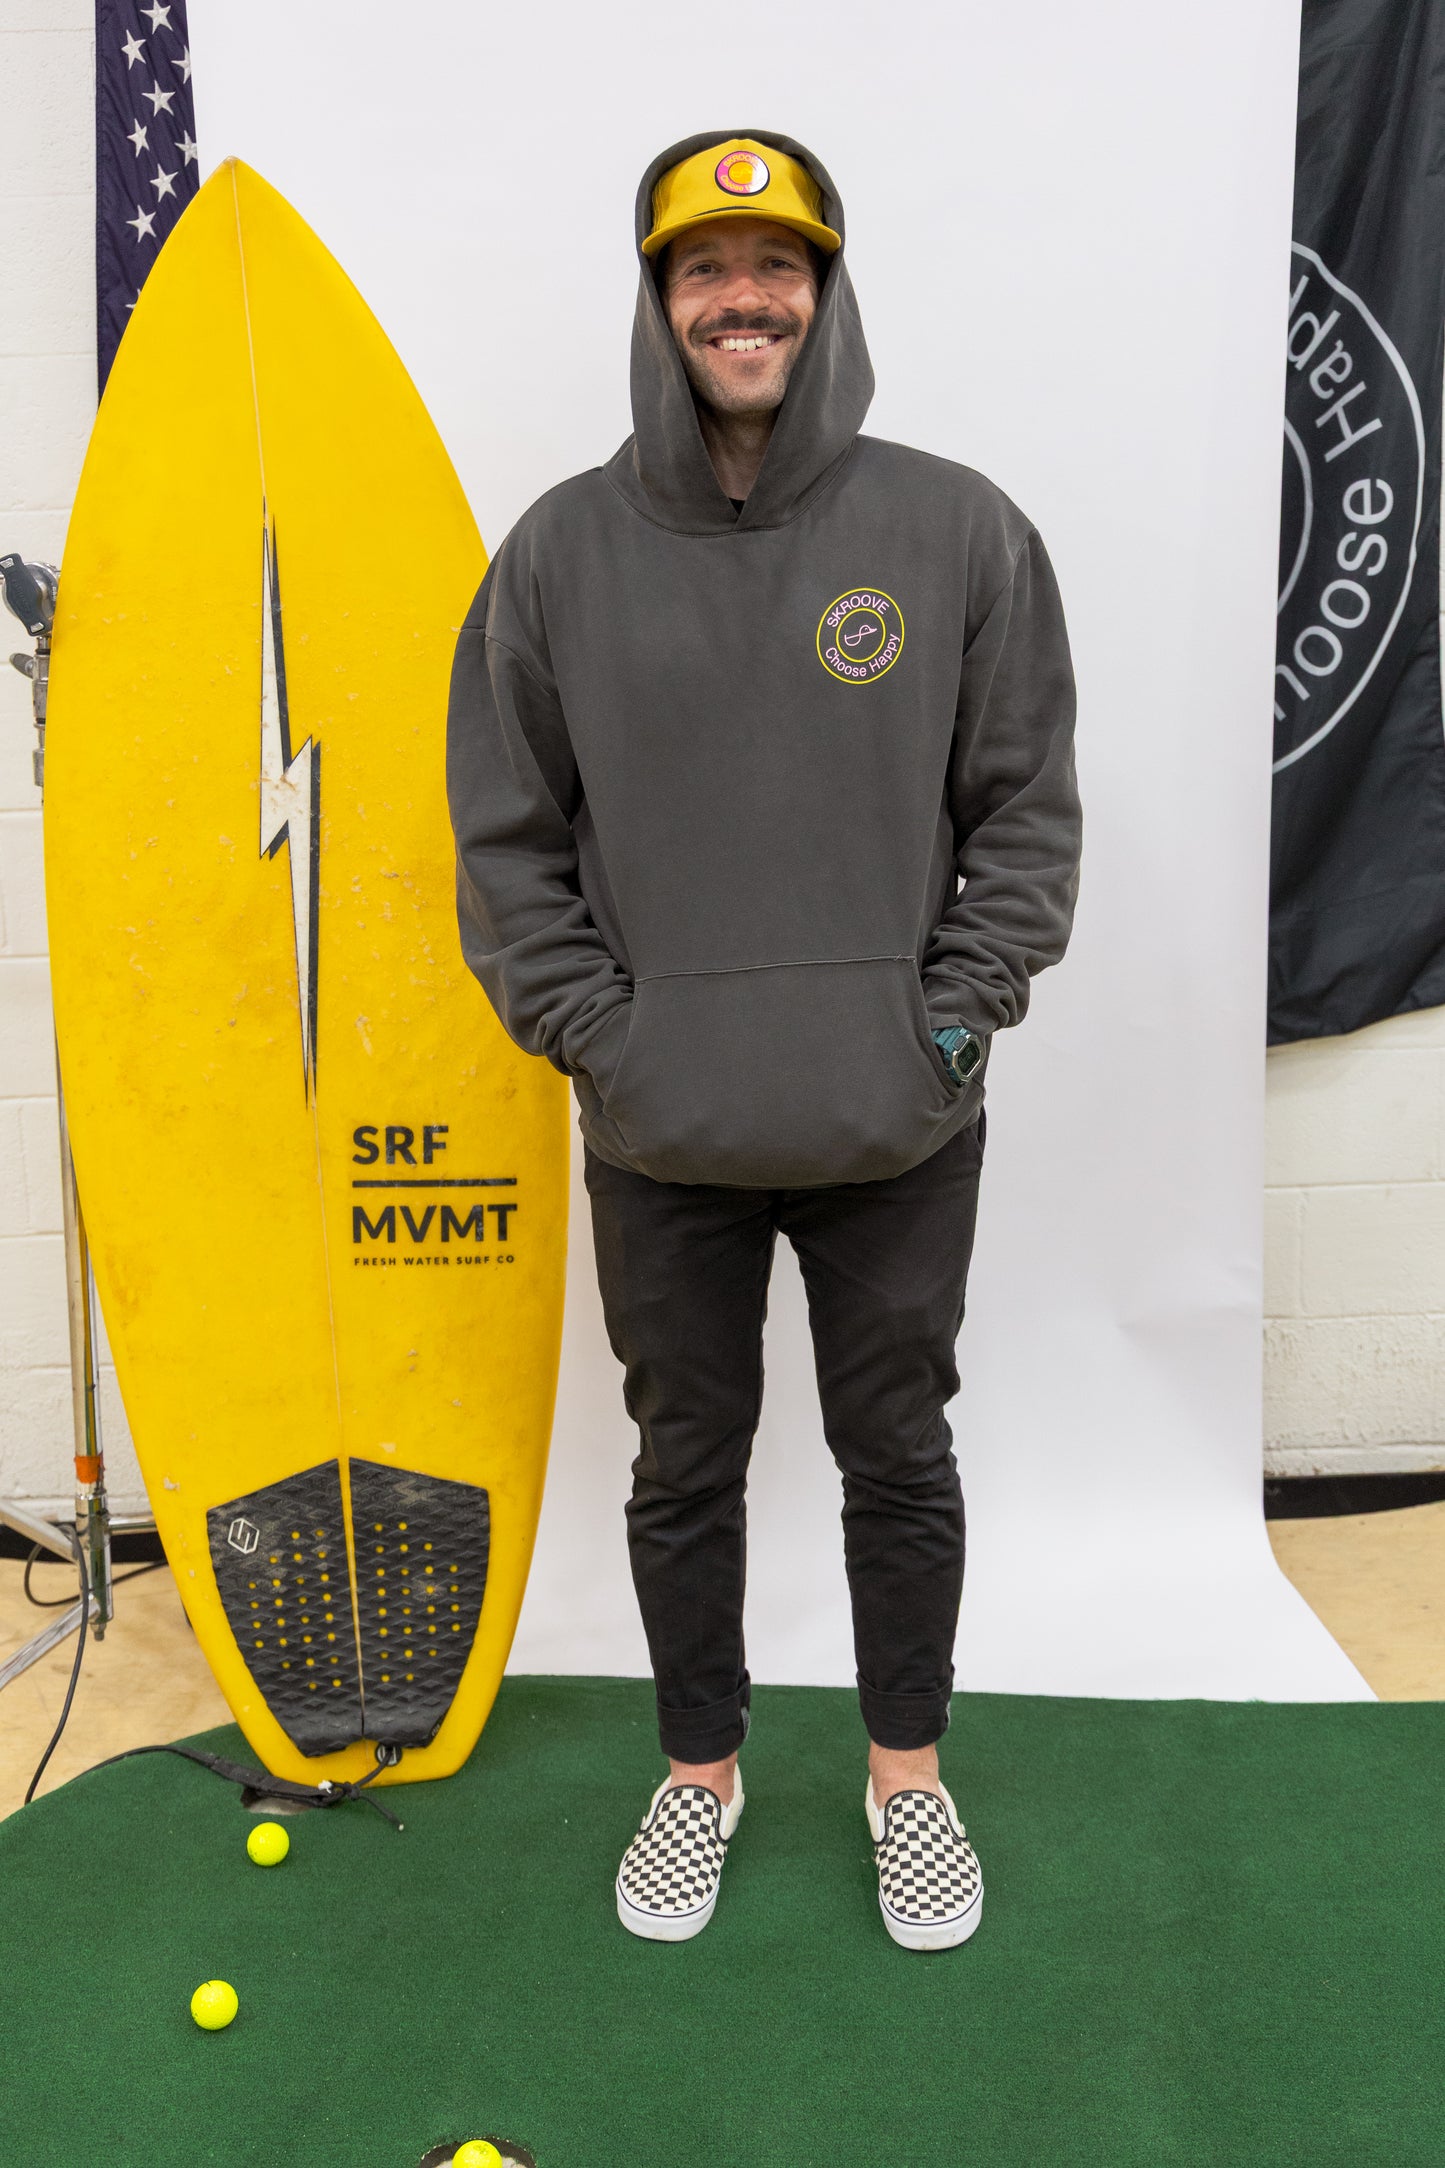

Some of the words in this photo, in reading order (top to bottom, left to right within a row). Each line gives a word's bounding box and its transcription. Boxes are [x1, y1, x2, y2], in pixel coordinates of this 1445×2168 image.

[723, 154, 758, 167] SKROO
[826, 594, 890, 628] SKROOVE
[825, 647, 867, 677] Choose
[868, 633, 901, 673] Happy
[352, 1125, 449, 1165] SRF
[352, 1203, 518, 1243] MVMT
[354, 1257, 397, 1266] FRESH
[403, 1256, 450, 1265] WATER
[456, 1256, 490, 1265] SURF
[496, 1254, 515, 1264] CO
